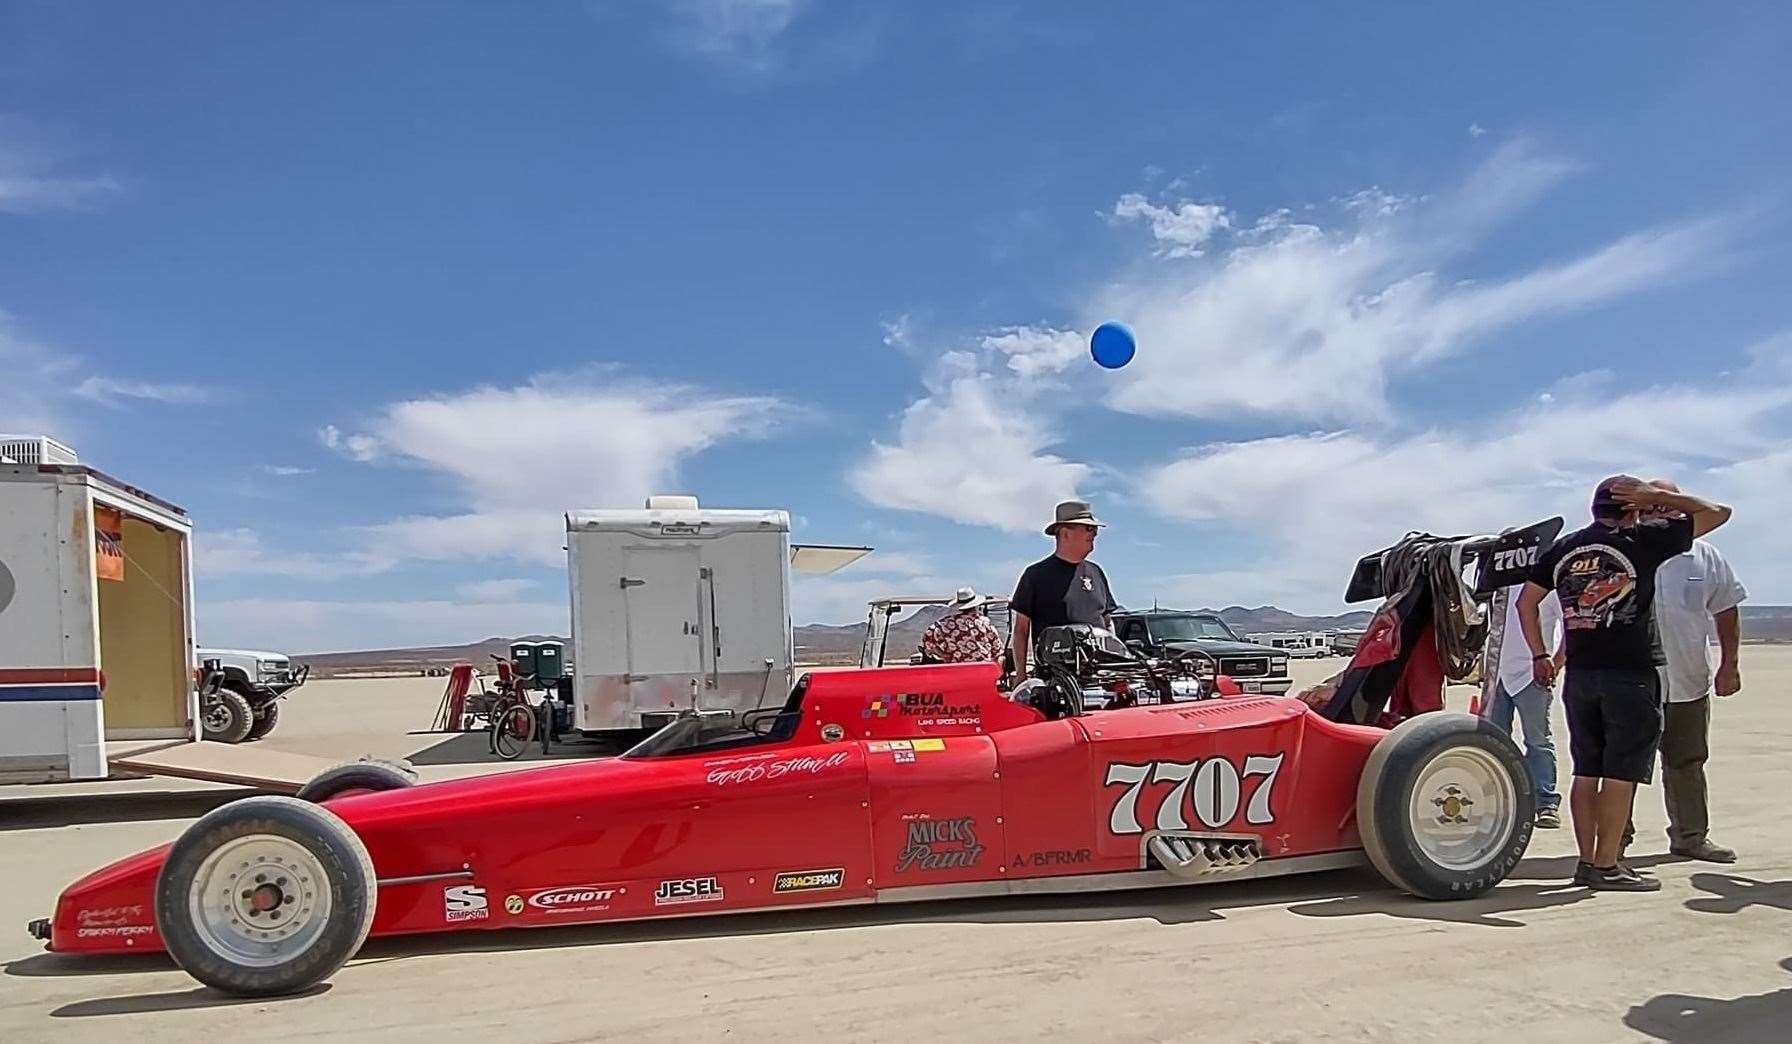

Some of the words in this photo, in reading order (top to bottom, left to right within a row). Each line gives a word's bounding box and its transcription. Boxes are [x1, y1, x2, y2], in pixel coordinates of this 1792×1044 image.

[1494, 546, 1539, 571] 7707
[1571, 557, 1600, 573] 911
[905, 693, 944, 706] BUA
[1105, 752, 1285, 835] 7707
[896, 844, 984, 873] Paint
[656, 878, 722, 899] JESEL
[787, 873, 839, 888] RACEPAK
[541, 889, 616, 905] SCHOTT
[448, 909, 487, 920] SIMPSON
